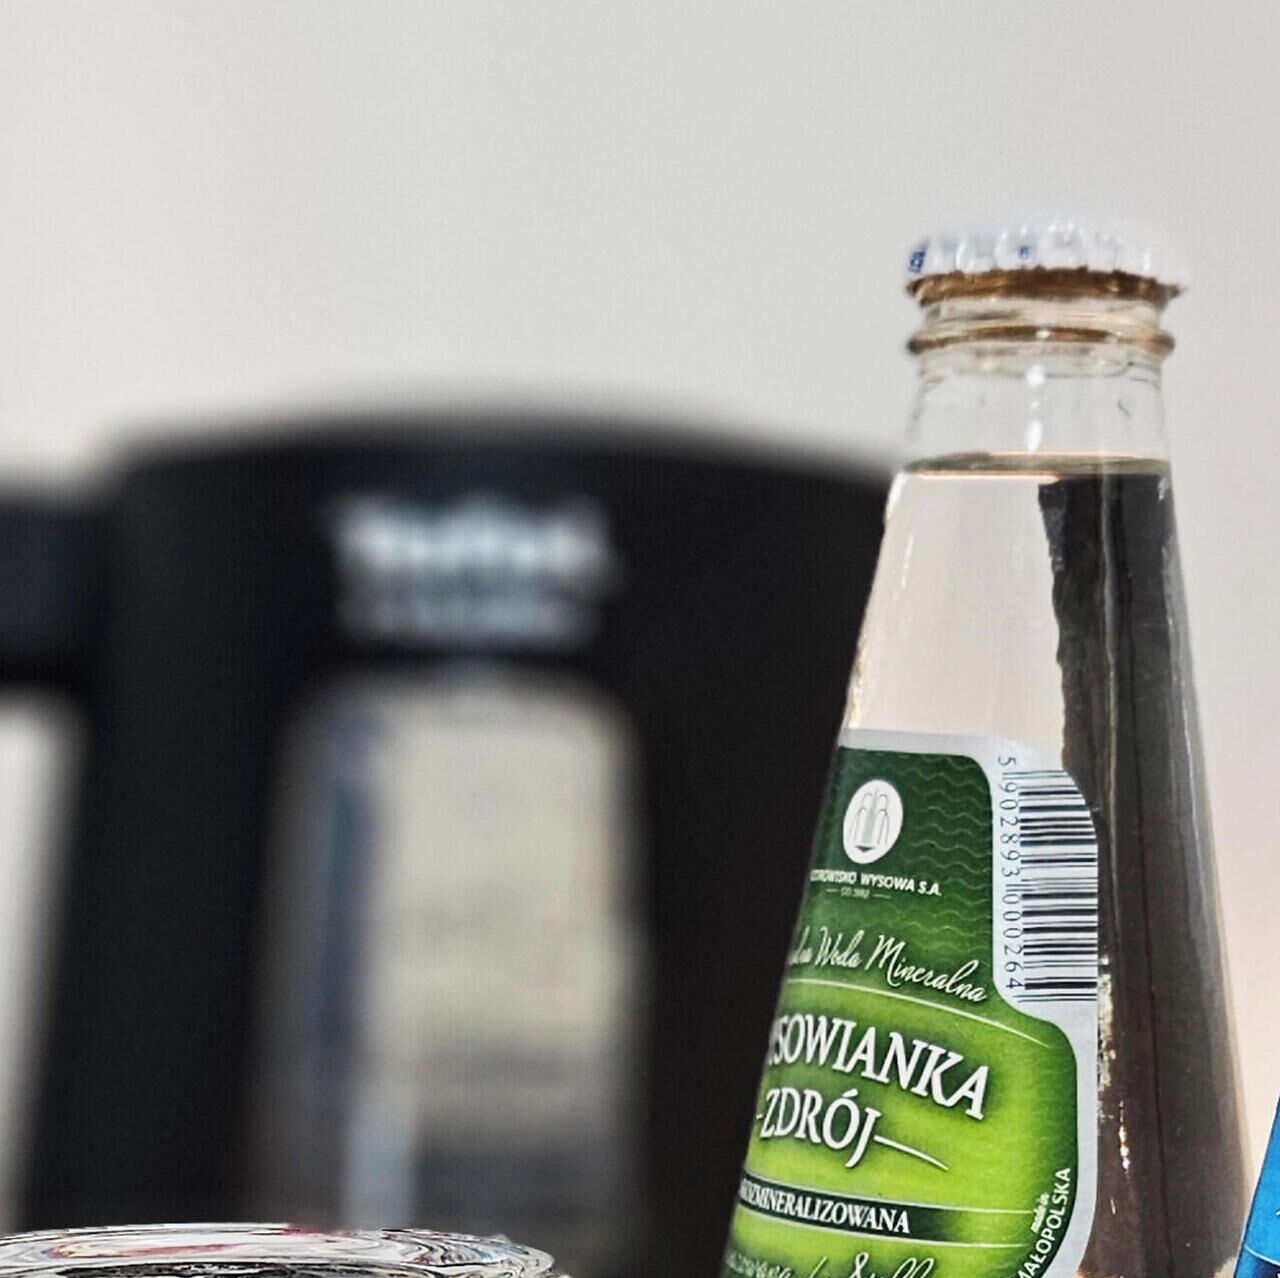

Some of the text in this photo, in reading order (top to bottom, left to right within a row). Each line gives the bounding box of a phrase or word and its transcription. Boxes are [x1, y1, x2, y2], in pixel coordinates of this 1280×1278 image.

[864, 934, 987, 1002] Mineralna
[767, 1013, 990, 1121] SOWIANKA
[760, 1088, 882, 1169] ZDRÓJ
